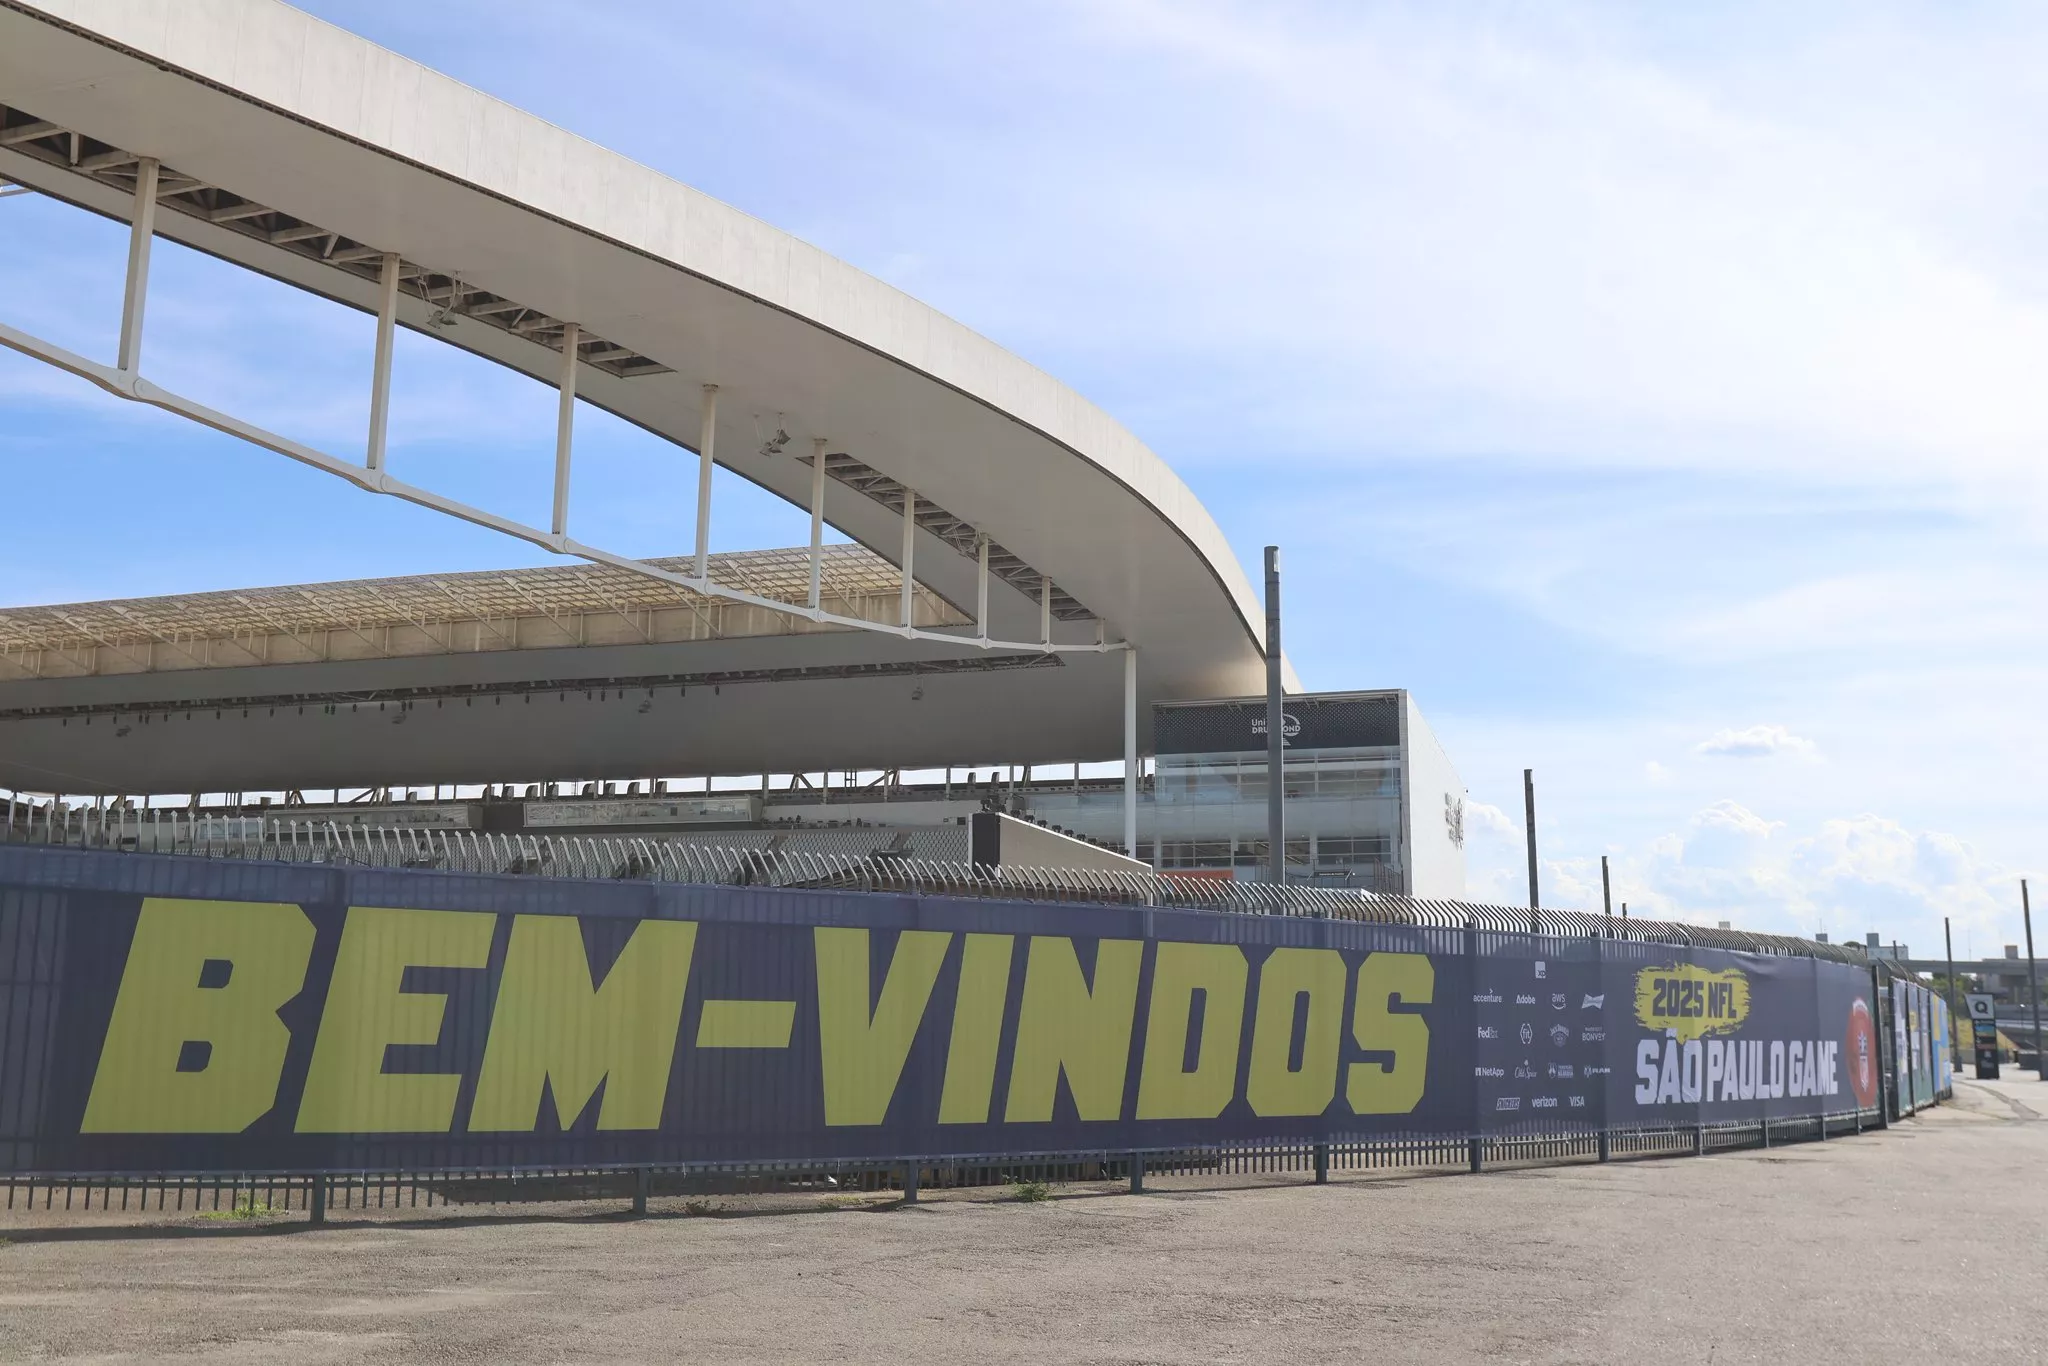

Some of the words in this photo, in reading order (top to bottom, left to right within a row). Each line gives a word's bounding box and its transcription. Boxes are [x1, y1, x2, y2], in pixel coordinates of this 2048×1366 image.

[1251, 718, 1266, 727] Uni
[1251, 725, 1301, 734] DRUOND
[1473, 994, 1503, 1003] accenture
[1516, 994, 1536, 1005] Adobe
[1552, 993, 1566, 1003] aws
[1652, 978, 1704, 1018] 2025
[1708, 981, 1737, 1019] NFL
[1975, 1000, 1988, 1014] Q
[80, 897, 1435, 1134] BEM-VINDOS
[1635, 1028, 1702, 1105] SÃO
[1706, 1040, 1785, 1103] PAULO
[1789, 1040, 1839, 1098] GAME
[1482, 1067, 1504, 1079] NetApp
[1531, 1096, 1558, 1108] verizon
[1569, 1096, 1585, 1107] VISA
